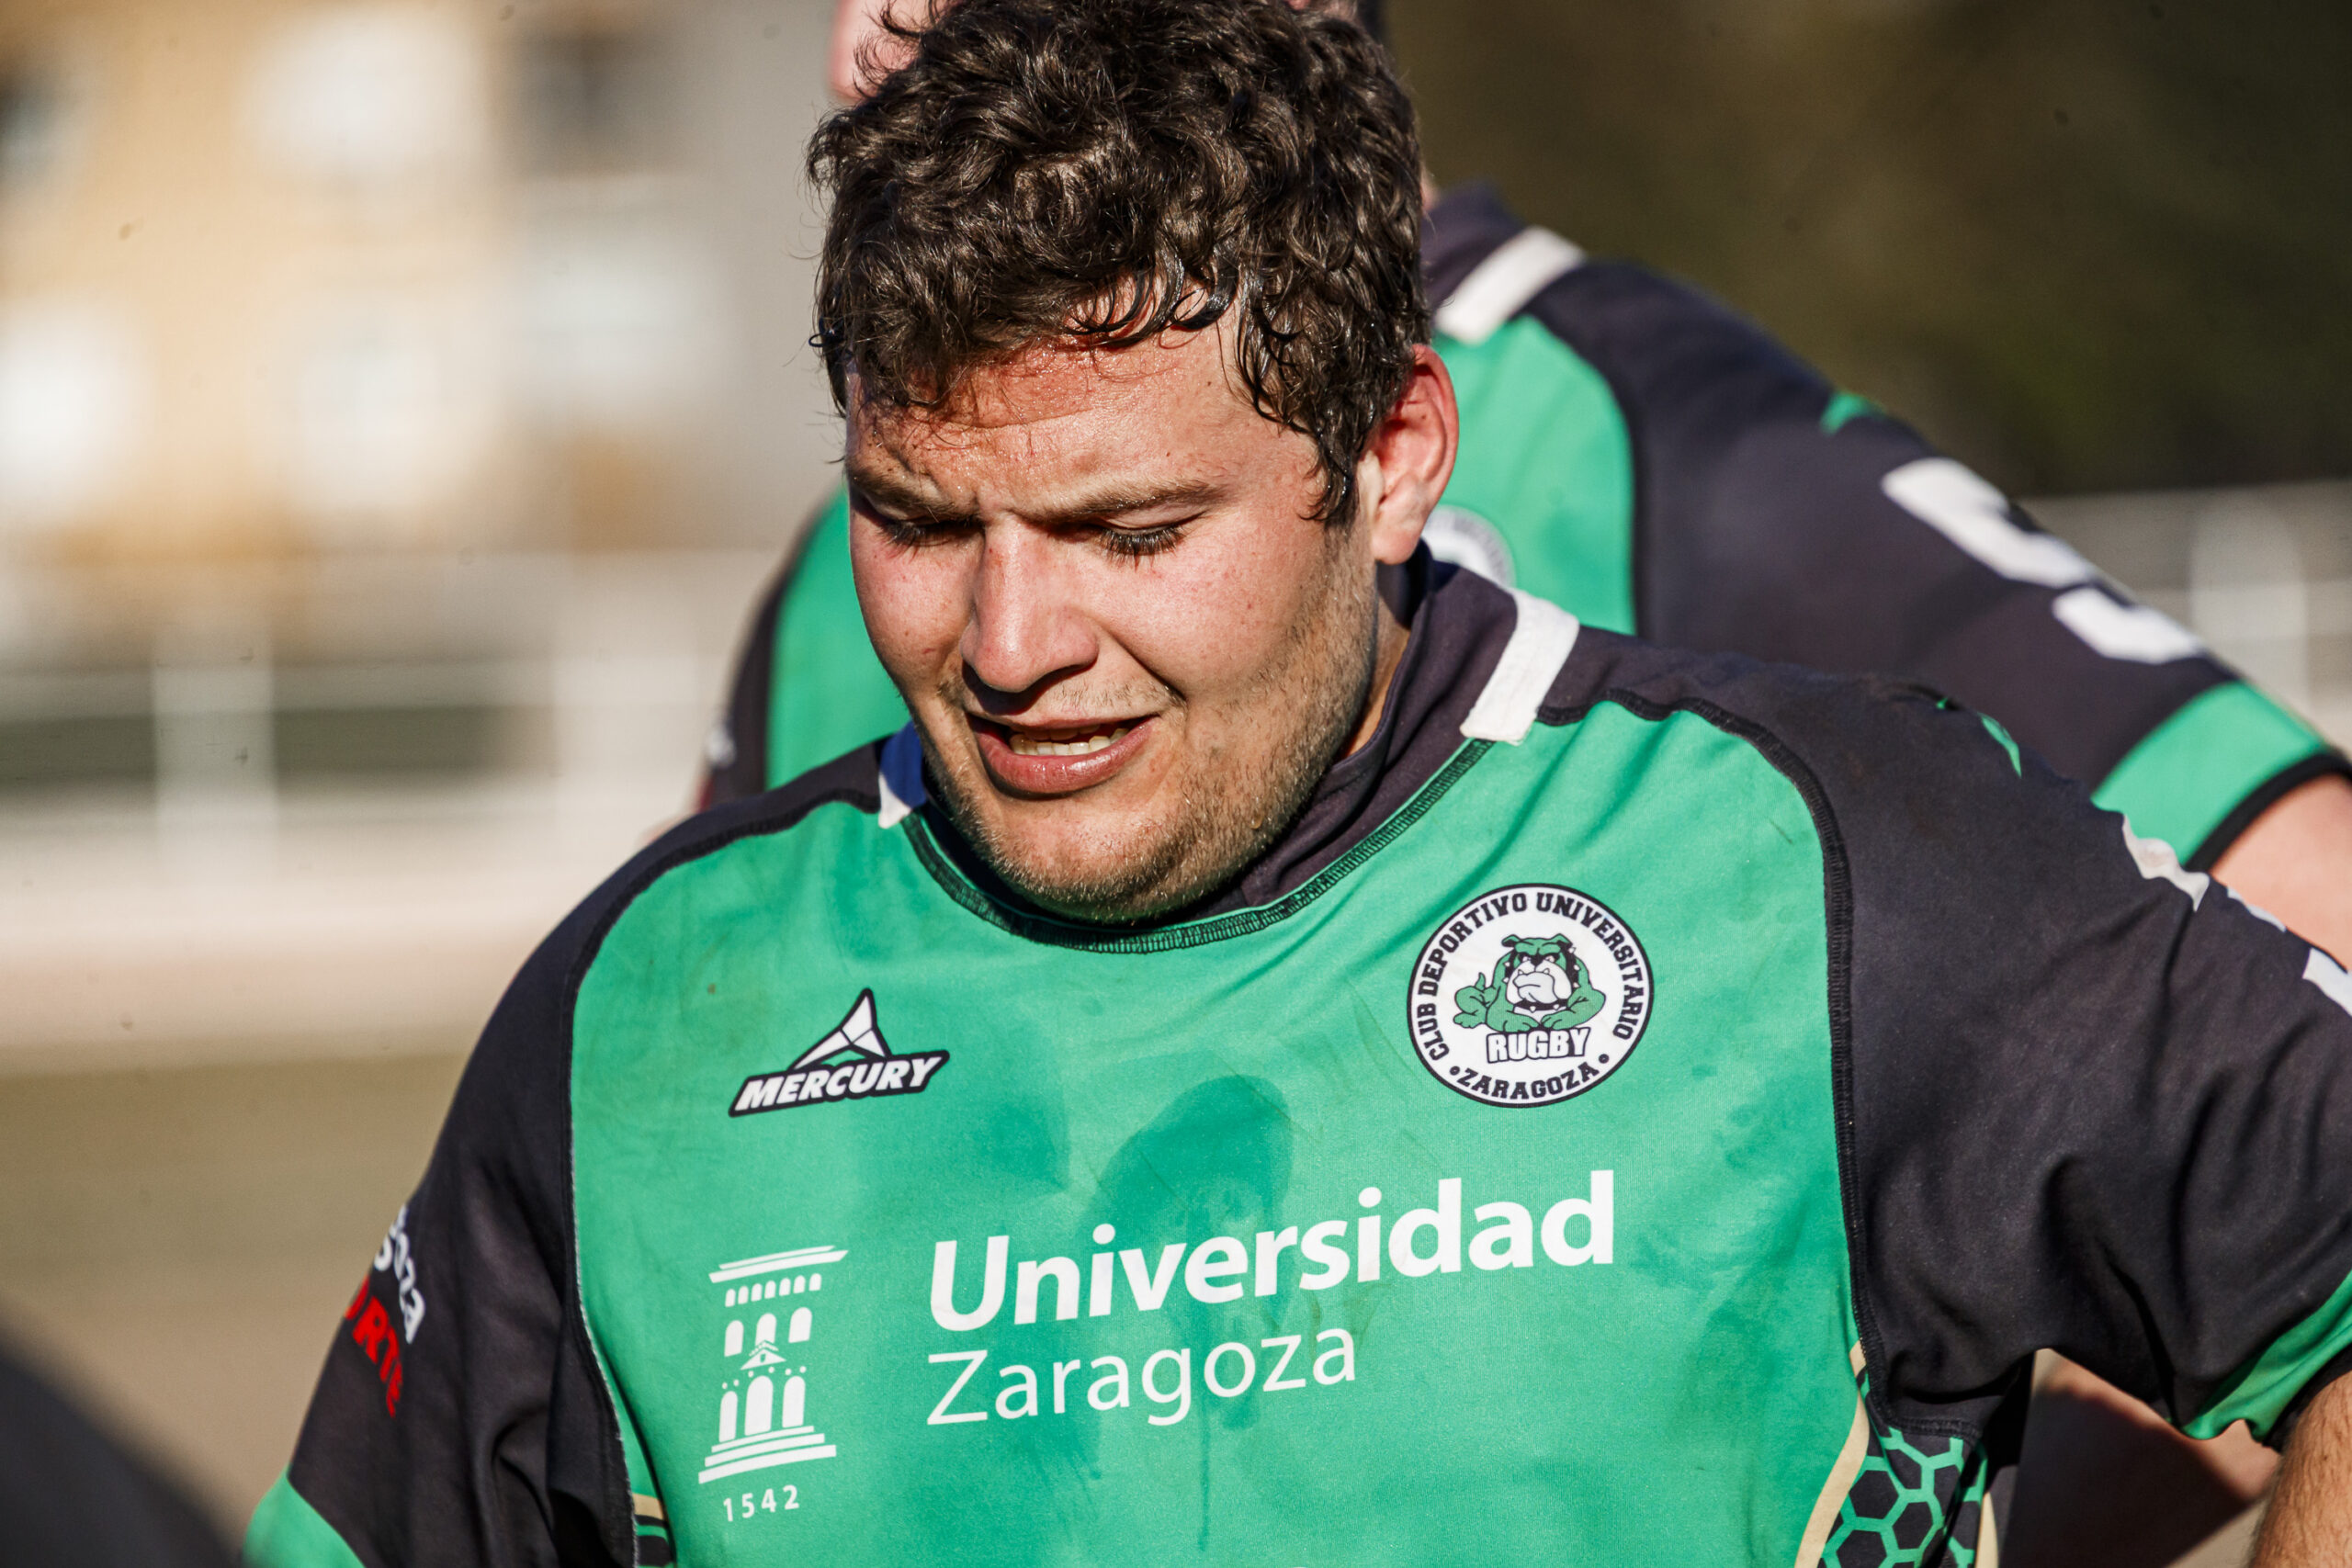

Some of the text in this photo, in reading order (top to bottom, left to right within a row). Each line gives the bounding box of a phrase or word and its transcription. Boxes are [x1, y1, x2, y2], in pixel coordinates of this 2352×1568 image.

[1417, 892, 1645, 1061] CLUB DEPORTIVO UNIVERSITARIO
[1487, 1026, 1591, 1064] RUGBY
[732, 1055, 946, 1113] MERCURY
[1456, 1061, 1600, 1100] ZARAGOZA
[930, 1168, 1614, 1332] Universidad
[926, 1327, 1356, 1427] Zaragoza
[723, 1484, 800, 1522] 1542
